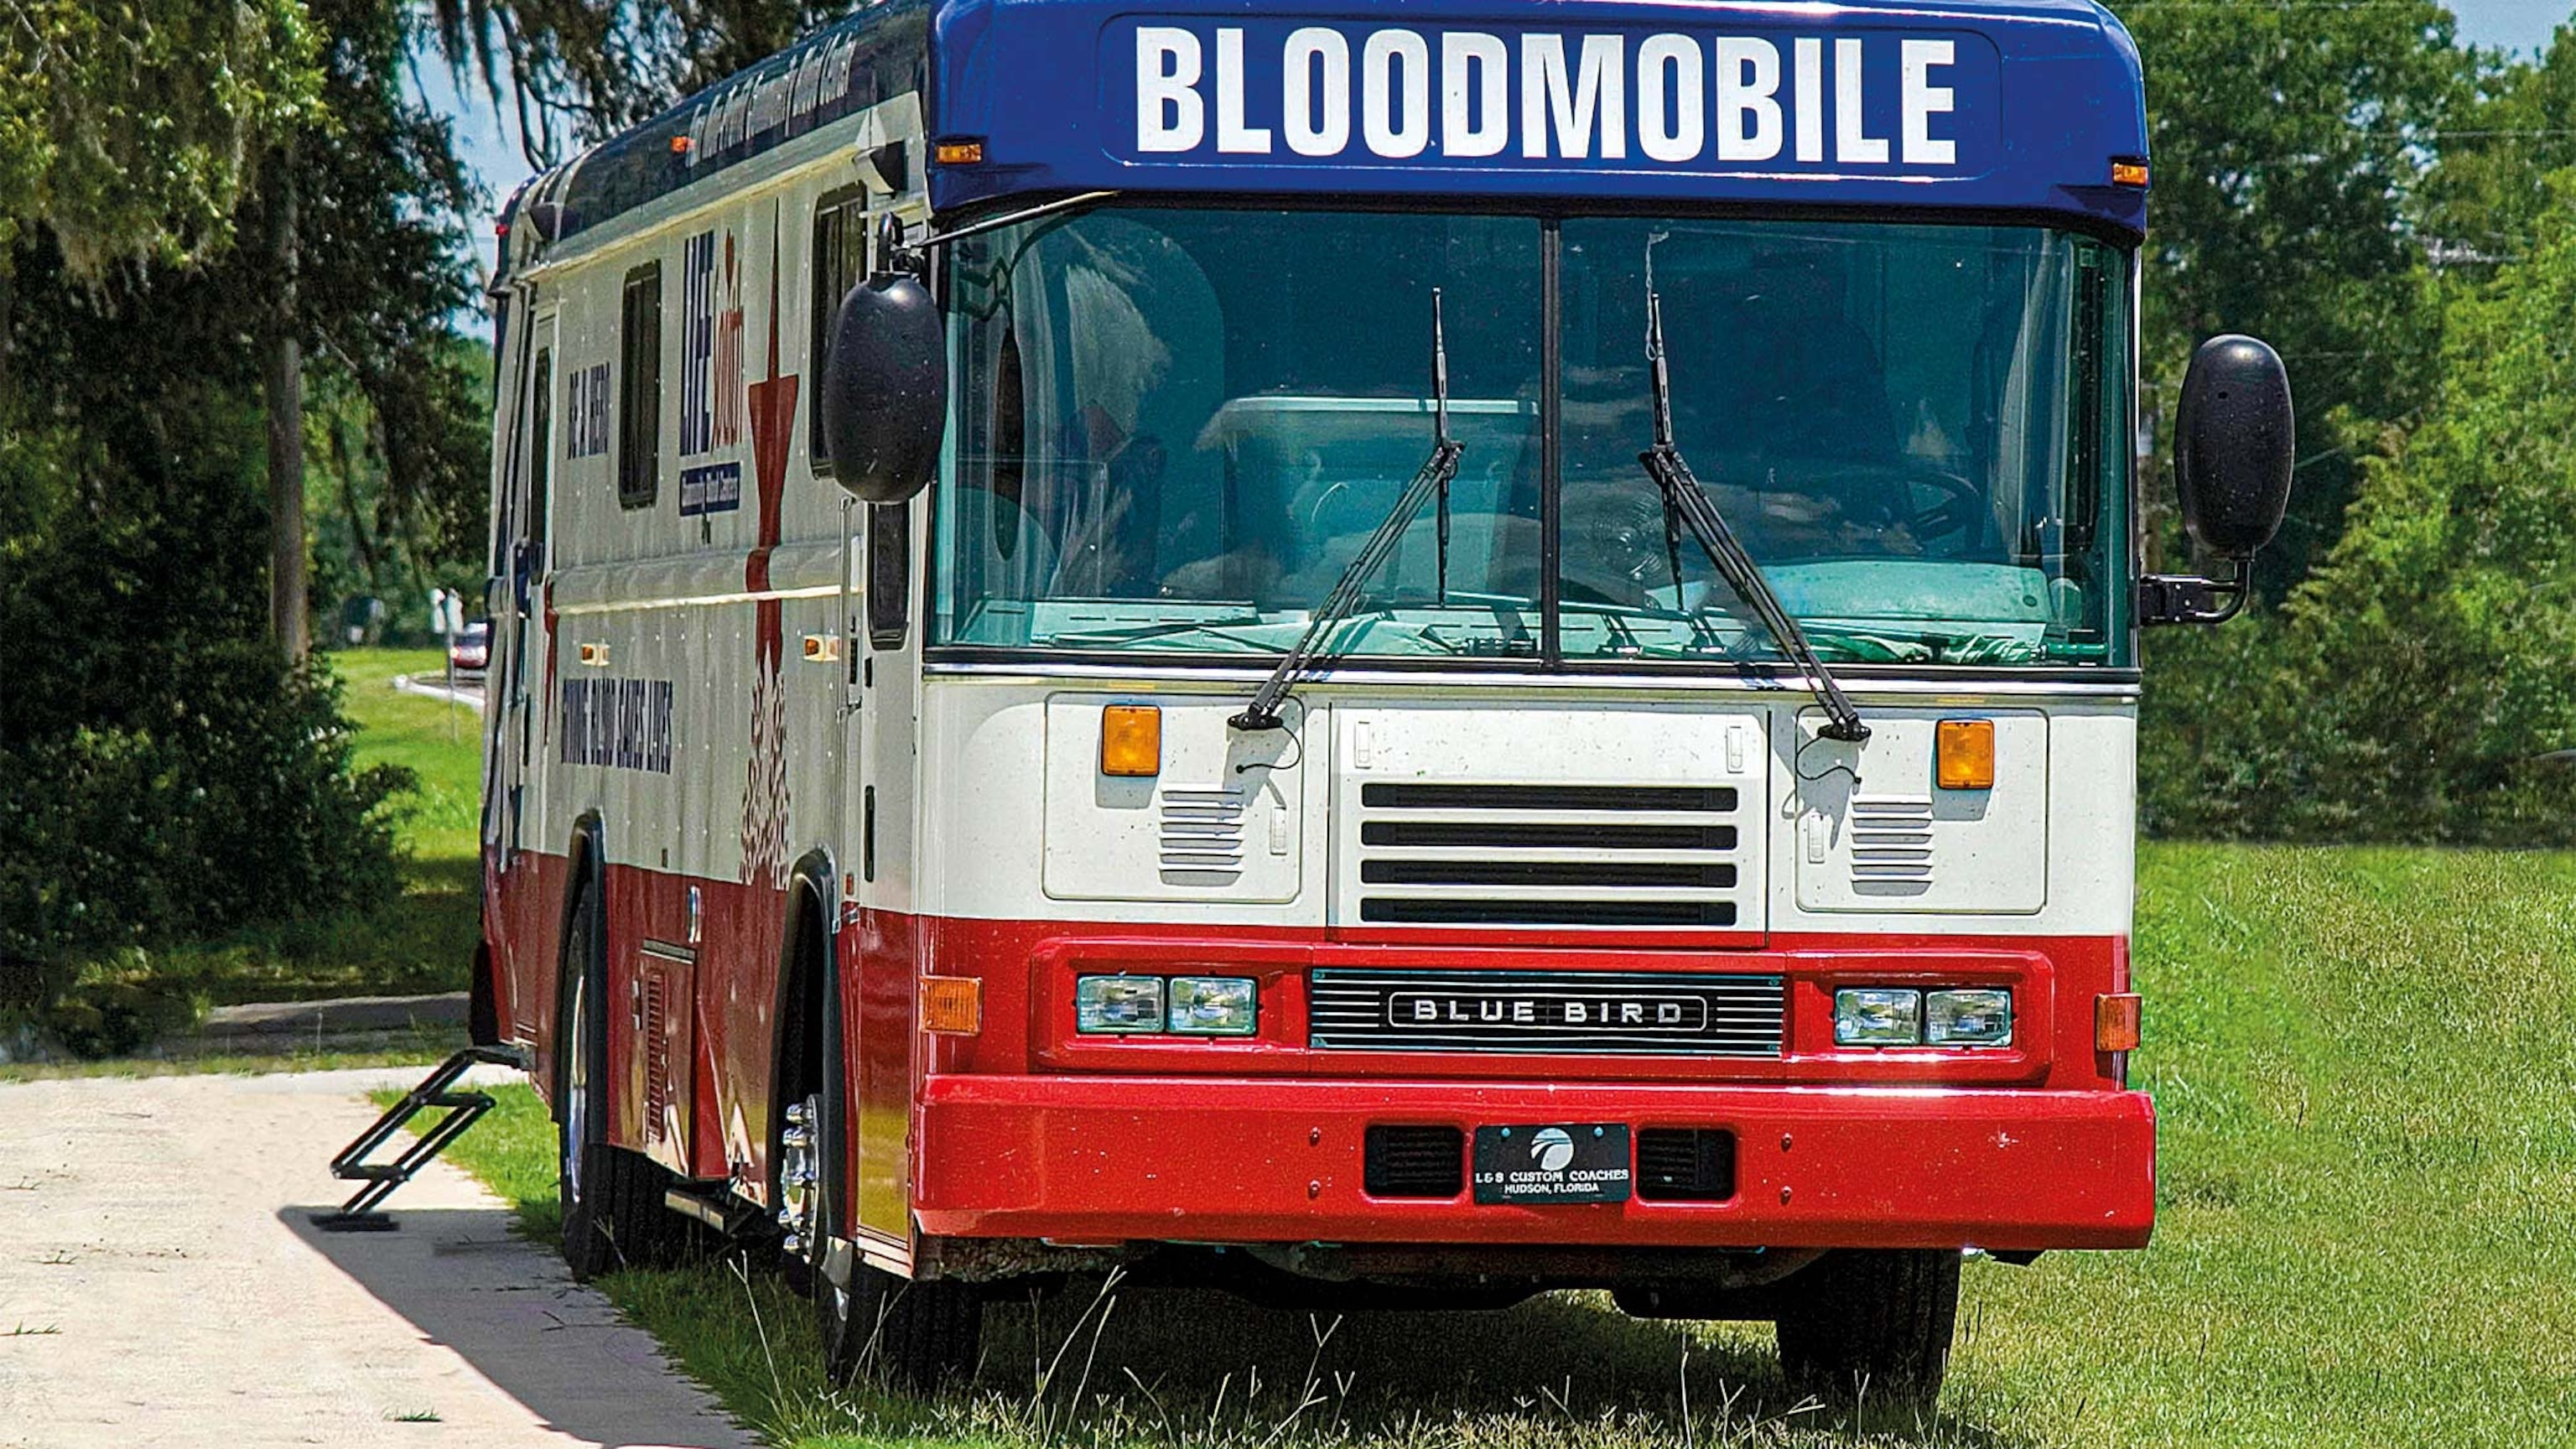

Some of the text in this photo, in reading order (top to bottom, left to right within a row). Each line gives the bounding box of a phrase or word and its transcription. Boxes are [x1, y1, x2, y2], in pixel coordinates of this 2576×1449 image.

[1136, 25, 1956, 165] BLOODMOBILE
[1414, 999, 1682, 1024] BLUE BIRD
[1509, 1171, 1564, 1183] CUSTOM
[1569, 1169, 1629, 1182] COACHES
[1504, 1182, 1600, 1195] HUDSON, FLORIDA
